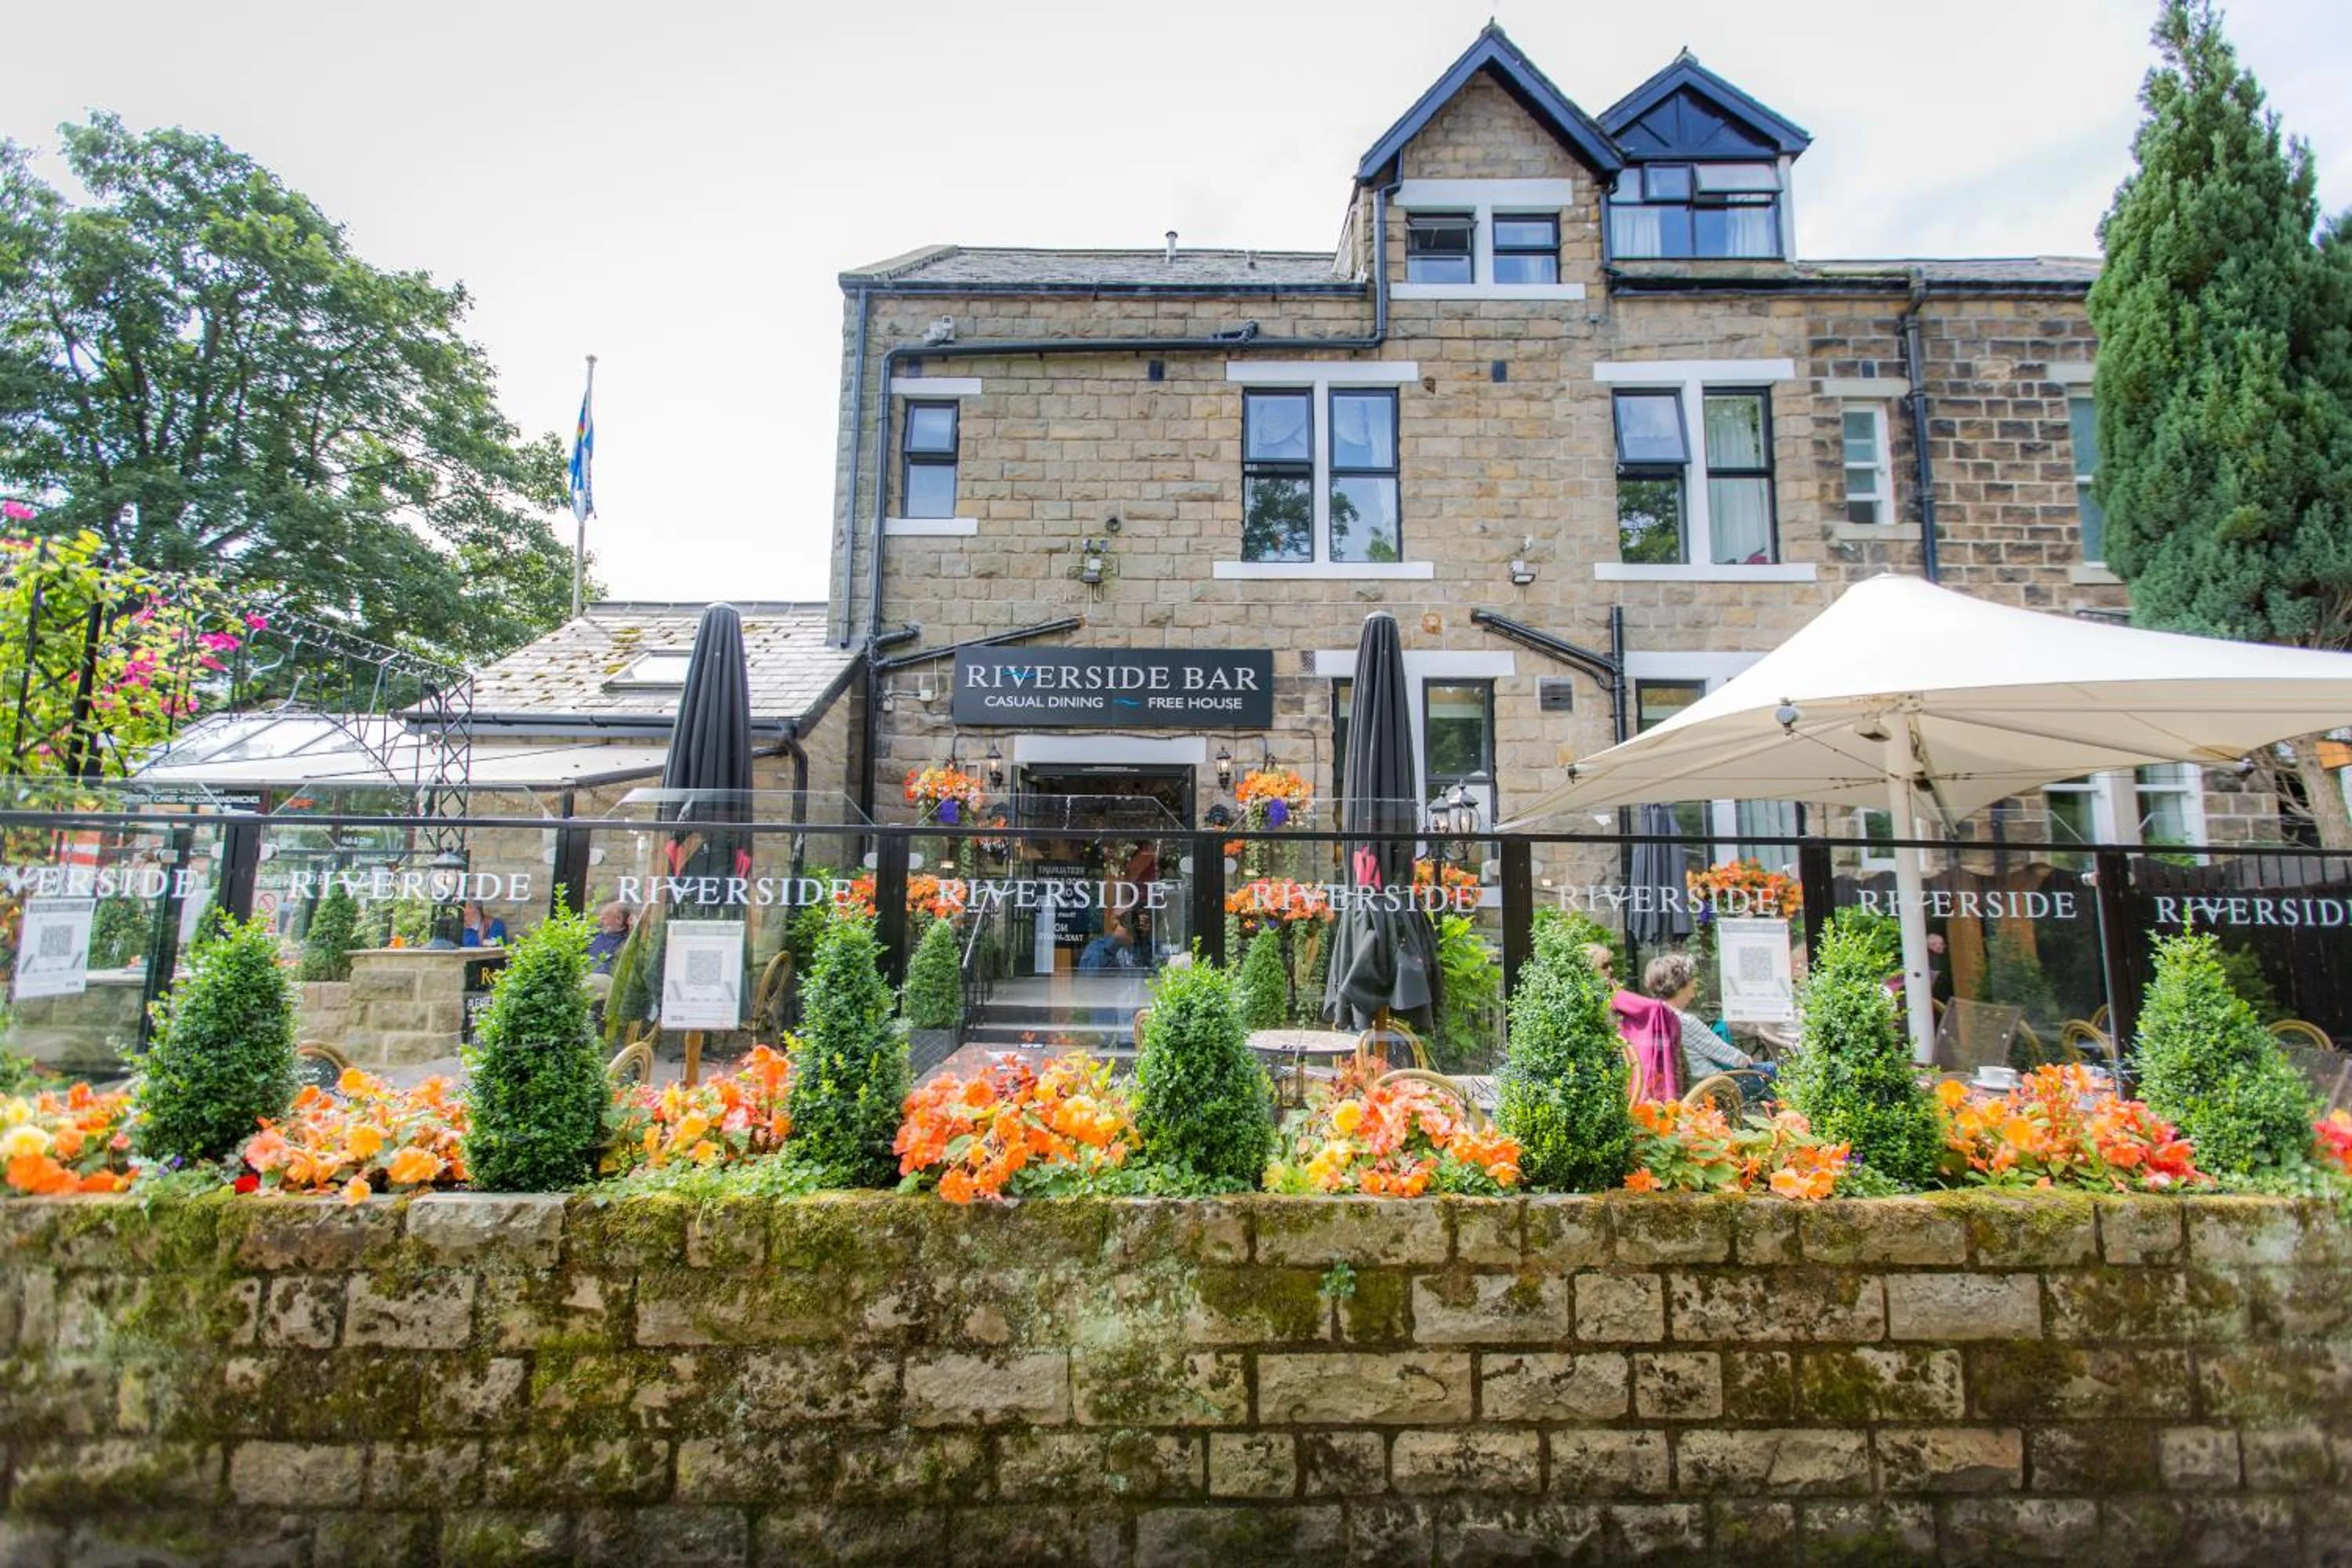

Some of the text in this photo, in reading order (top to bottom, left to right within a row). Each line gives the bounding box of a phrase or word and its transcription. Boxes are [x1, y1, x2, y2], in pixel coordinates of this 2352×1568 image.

[965, 665, 1260, 691] RIVERSIDE BAR
[984, 695, 1243, 710] CASUAL DINING FREE HOUSE
[290, 871, 532, 902] RIVERSIDE
[618, 876, 853, 906] RIVERSIDE
[940, 879, 1167, 909] RIVERSIDE
[1253, 884, 1477, 913] RIVERSIDE
[1559, 885, 1778, 915] RIVERSIDE
[1857, 889, 2077, 918] RIERSIDE
